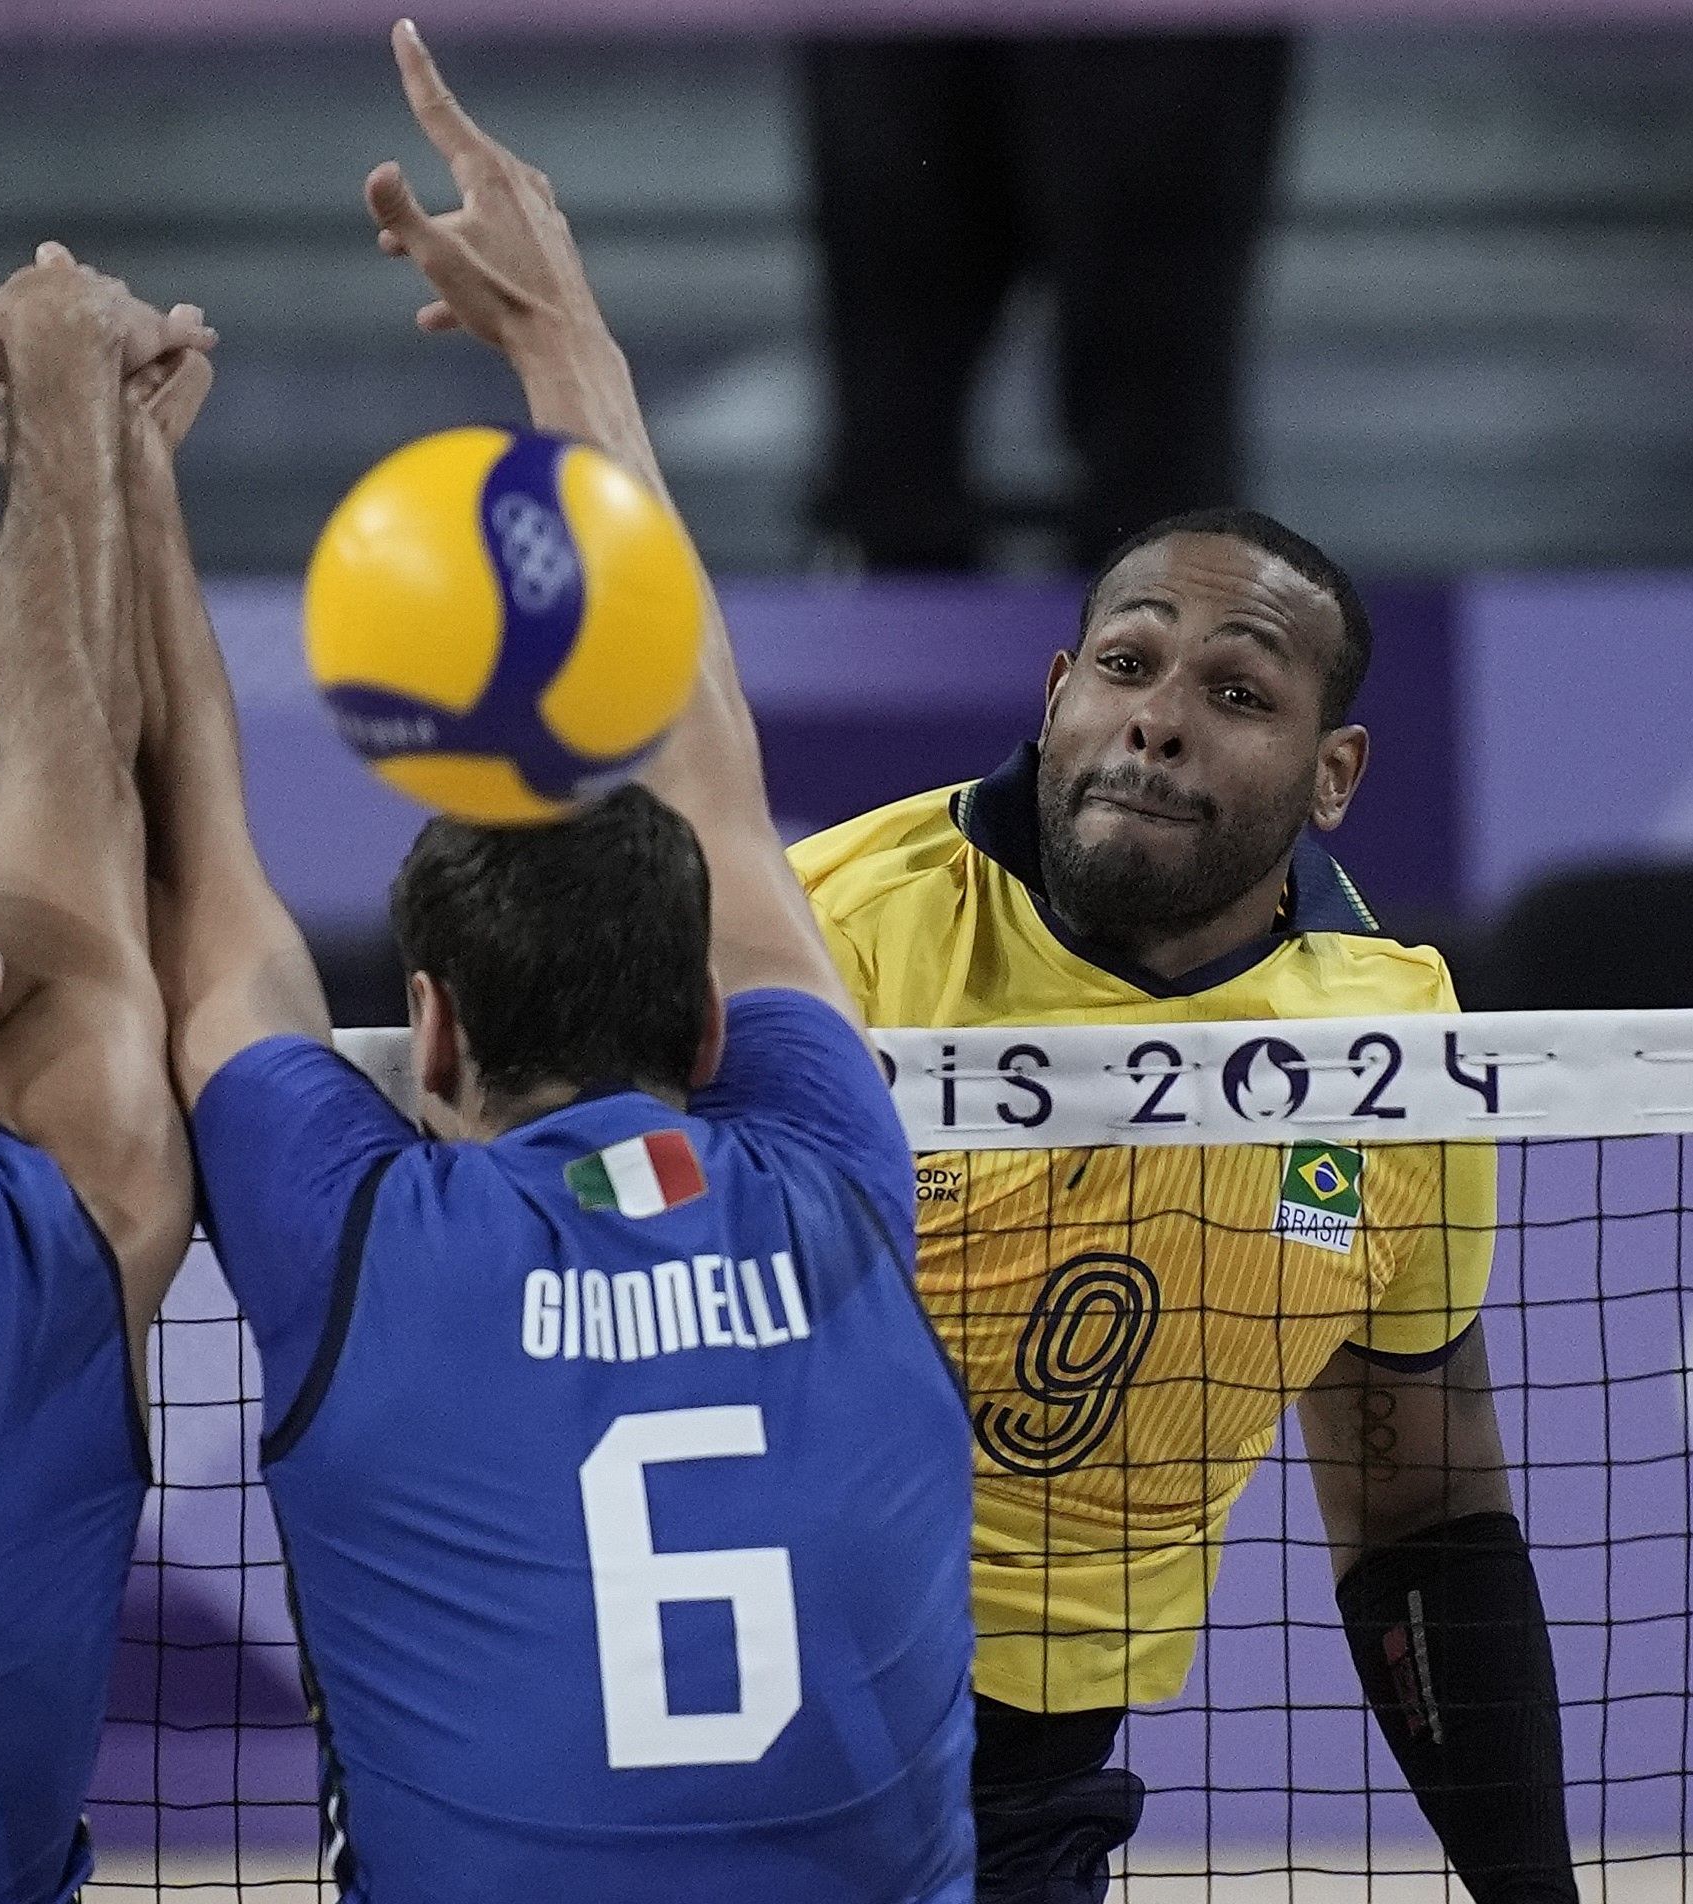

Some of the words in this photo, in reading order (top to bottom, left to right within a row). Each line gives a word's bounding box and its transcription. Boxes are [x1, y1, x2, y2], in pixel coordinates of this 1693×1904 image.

[879, 1043, 1052, 1127] iS
[916, 1168, 962, 1185] ODY
[916, 1186, 961, 1202] ORK
[1276, 1204, 1350, 1247] BRASIL
[521, 1252, 810, 1362] GIANNELLI
[974, 1252, 1160, 1478] 9
[579, 1404, 802, 1769] 6
